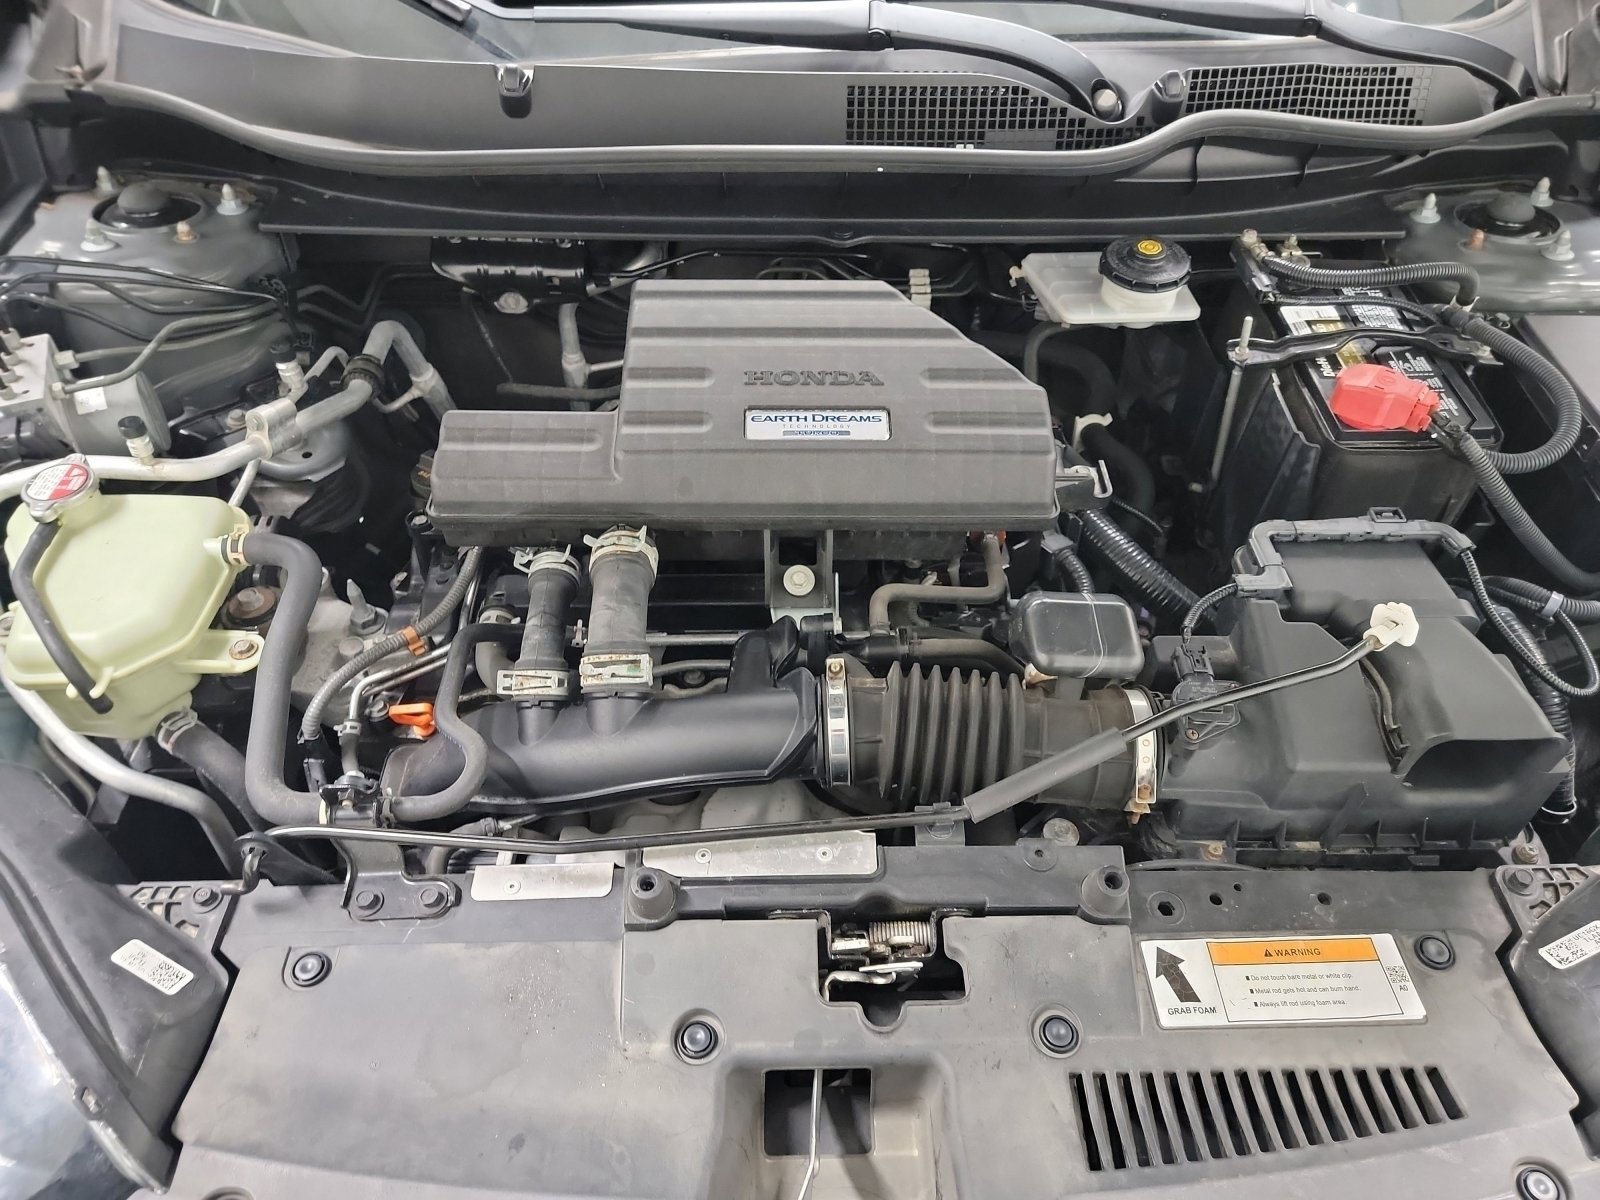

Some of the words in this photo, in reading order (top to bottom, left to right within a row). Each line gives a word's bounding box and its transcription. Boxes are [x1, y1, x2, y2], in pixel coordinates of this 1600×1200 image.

[1315, 357, 1336, 377] DieH
[744, 371, 884, 386] HONDA
[751, 415, 808, 423] EARTH
[811, 414, 883, 423] DREAMS
[1274, 948, 1321, 957] WARNING
[1282, 987, 1296, 995] gets
[1259, 1000, 1280, 1008] Always
[1300, 999, 1316, 1008] using
[1167, 1007, 1191, 1015] GRAB
[1193, 1006, 1217, 1014] FOAM
